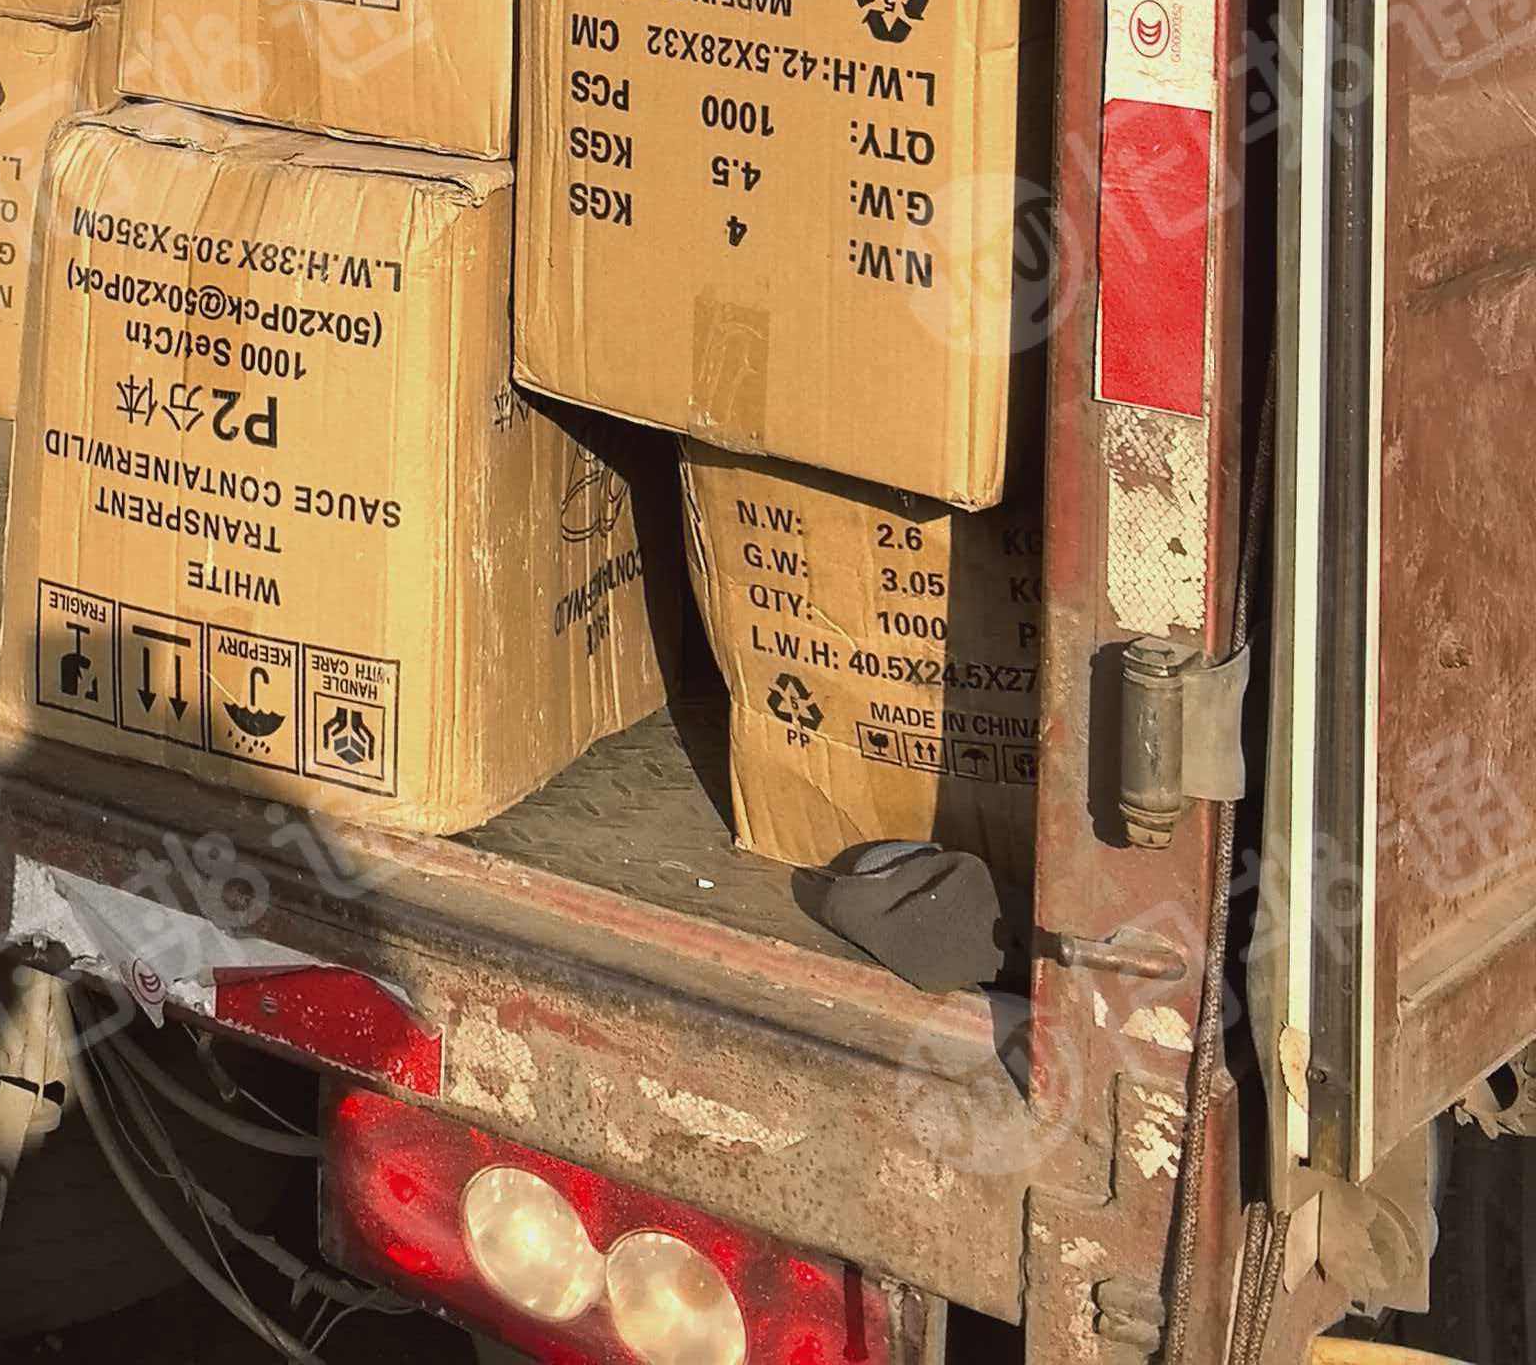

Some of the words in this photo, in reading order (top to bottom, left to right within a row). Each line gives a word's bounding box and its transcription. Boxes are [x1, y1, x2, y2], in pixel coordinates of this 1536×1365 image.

[571, 14, 619, 51] CM
[647, 24, 936, 107] L.W.H:42.5X28X32
[571, 71, 630, 111] PCS
[701, 94, 774, 137] 1000
[569, 128, 633, 169] KGS
[850, 121, 935, 165] QTY:
[711, 155, 761, 192] 4.5
[569, 184, 633, 226] KGS
[849, 180, 935, 226] G.W:
[73, 206, 403, 293] L.W.H:38X30.5X35CM
[726, 215, 747, 247] 4
[849, 239, 933, 288] N.W:
[67, 257, 383, 348] (50x20Pck@50x20Pck)
[126, 319, 232, 367] Set/Ctn
[241, 349, 307, 381] 1000
[115, 374, 279, 449] P2分体
[44, 428, 282, 507] CONTAINERW/LID
[94, 486, 282, 553] TRANSPRENT
[294, 485, 402, 529] SAUCE
[736, 500, 803, 535] N.W:
[877, 524, 923, 551] 2.6
[187, 560, 281, 606] WHITE
[743, 543, 808, 577] G.W:
[882, 568, 945, 597] 3.05
[49, 591, 107, 623] FRAGILE
[749, 585, 813, 620] QTY:
[877, 612, 946, 640] 1000
[217, 632, 292, 666] KEEPDRY
[322, 675, 378, 699] HANDLE
